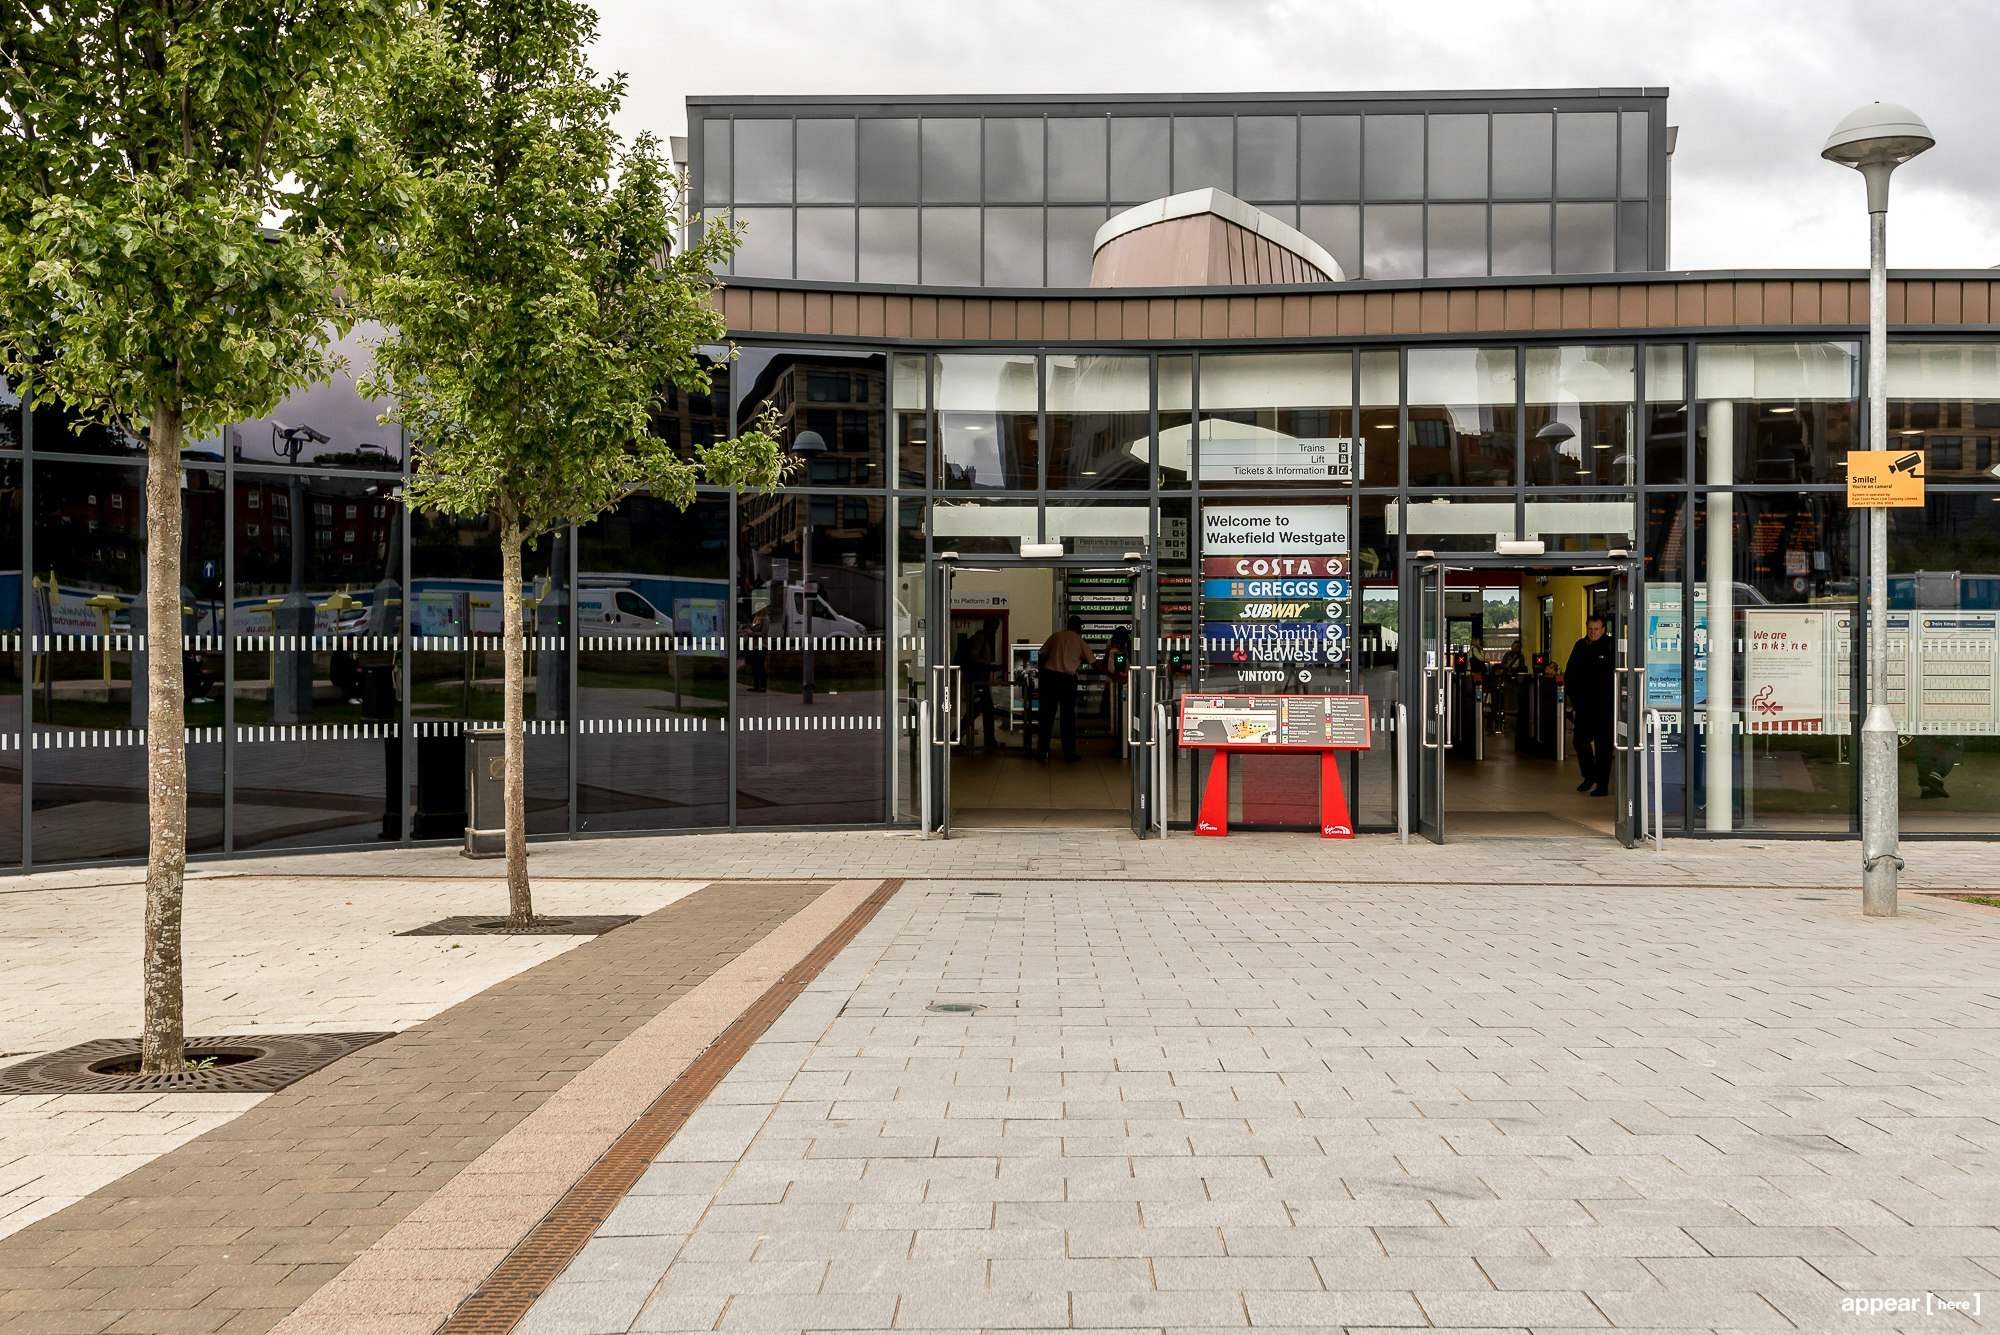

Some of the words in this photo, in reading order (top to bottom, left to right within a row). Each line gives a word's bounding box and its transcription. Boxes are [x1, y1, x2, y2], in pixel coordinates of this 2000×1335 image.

[1299, 443, 1325, 452] Trains
[1311, 455, 1325, 464] Lift
[1234, 466, 1265, 475] Tickets
[1266, 466, 1274, 475] &
[1276, 466, 1326, 475] Information
[1852, 476, 1877, 484] Smile!
[1206, 515, 1271, 526] Welcome
[1275, 516, 1290, 526] to
[1206, 532, 1275, 544] Wakefield
[1279, 532, 1346, 545] Westgate
[1236, 559, 1312, 575] COSTA
[1248, 582, 1318, 596] GREGGS
[1239, 603, 1310, 618] SUBWAY
[1232, 625, 1317, 640] WHSmith
[1754, 631, 1768, 639] We
[1252, 648, 1318, 661] NatWest
[1238, 671, 1284, 681] VINTOTO
